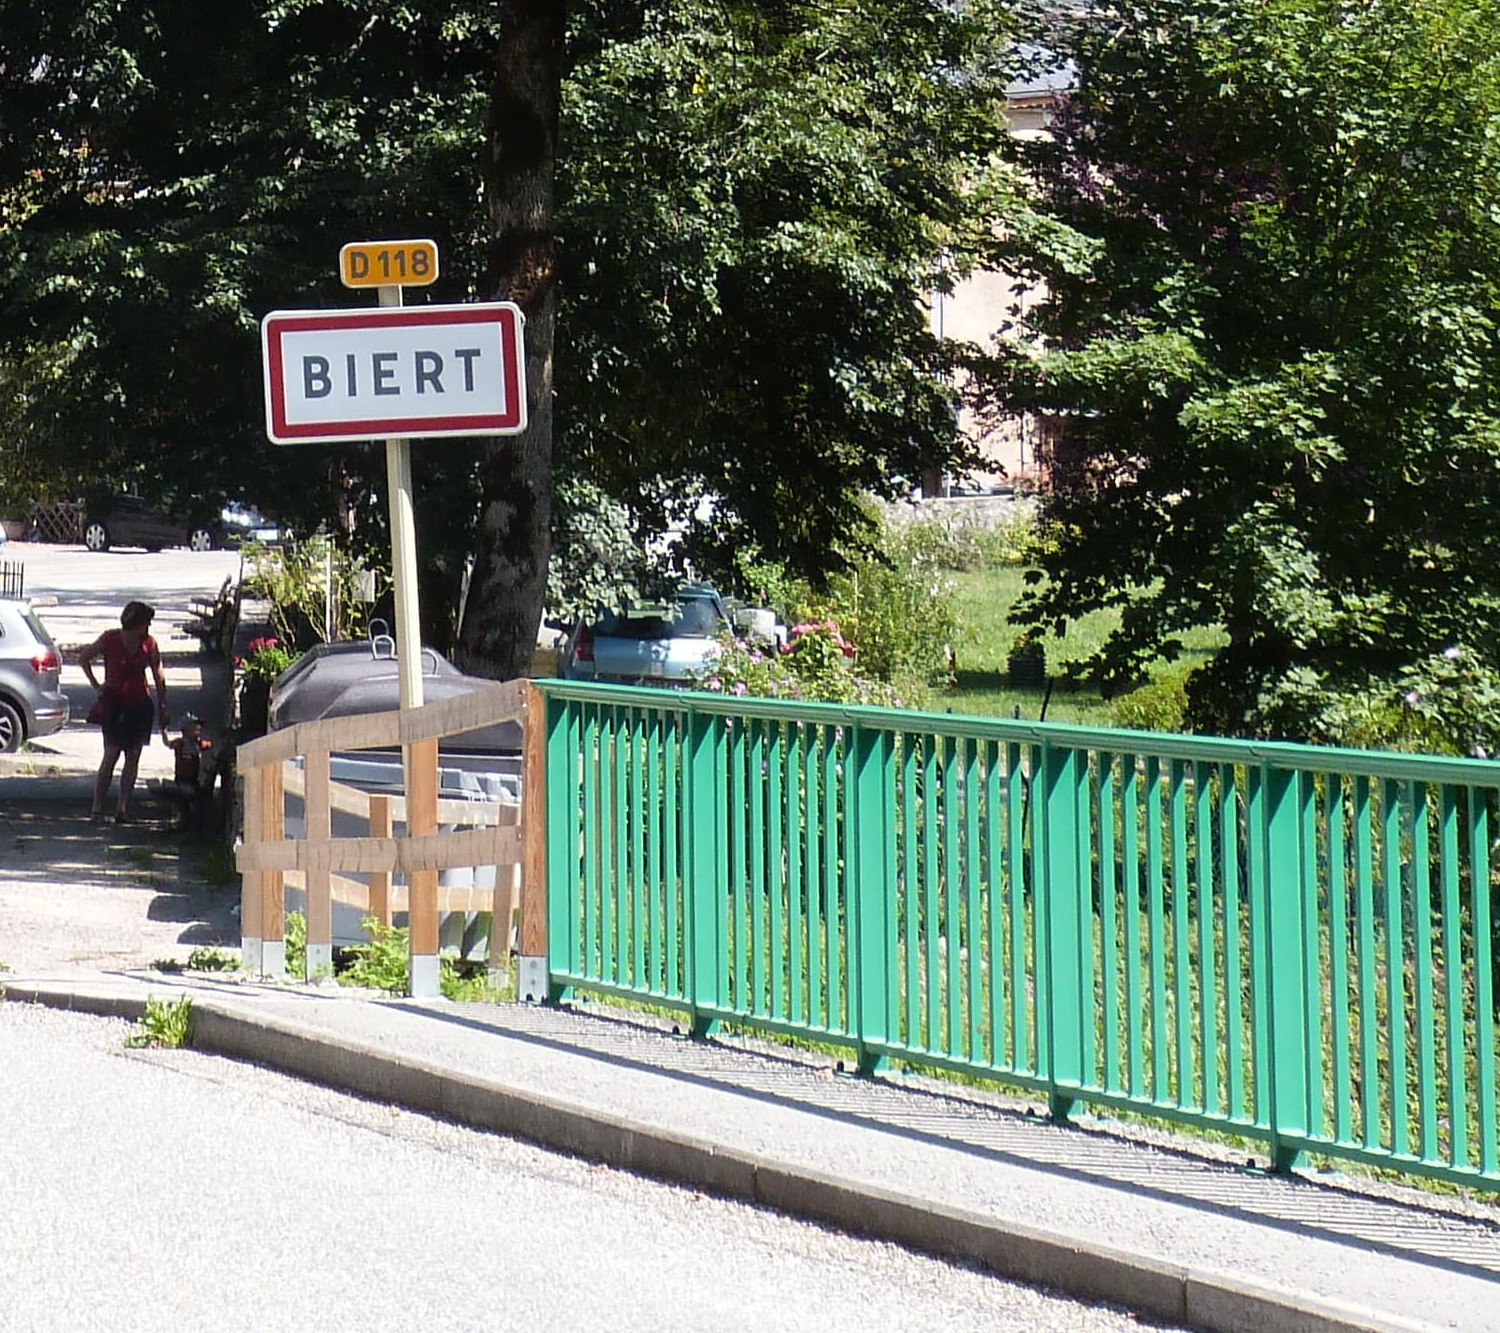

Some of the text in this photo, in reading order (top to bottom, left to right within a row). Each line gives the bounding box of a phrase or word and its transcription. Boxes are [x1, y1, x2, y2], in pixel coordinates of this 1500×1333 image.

[349, 248, 430, 279] D 118
[302, 348, 482, 400] BIERT
